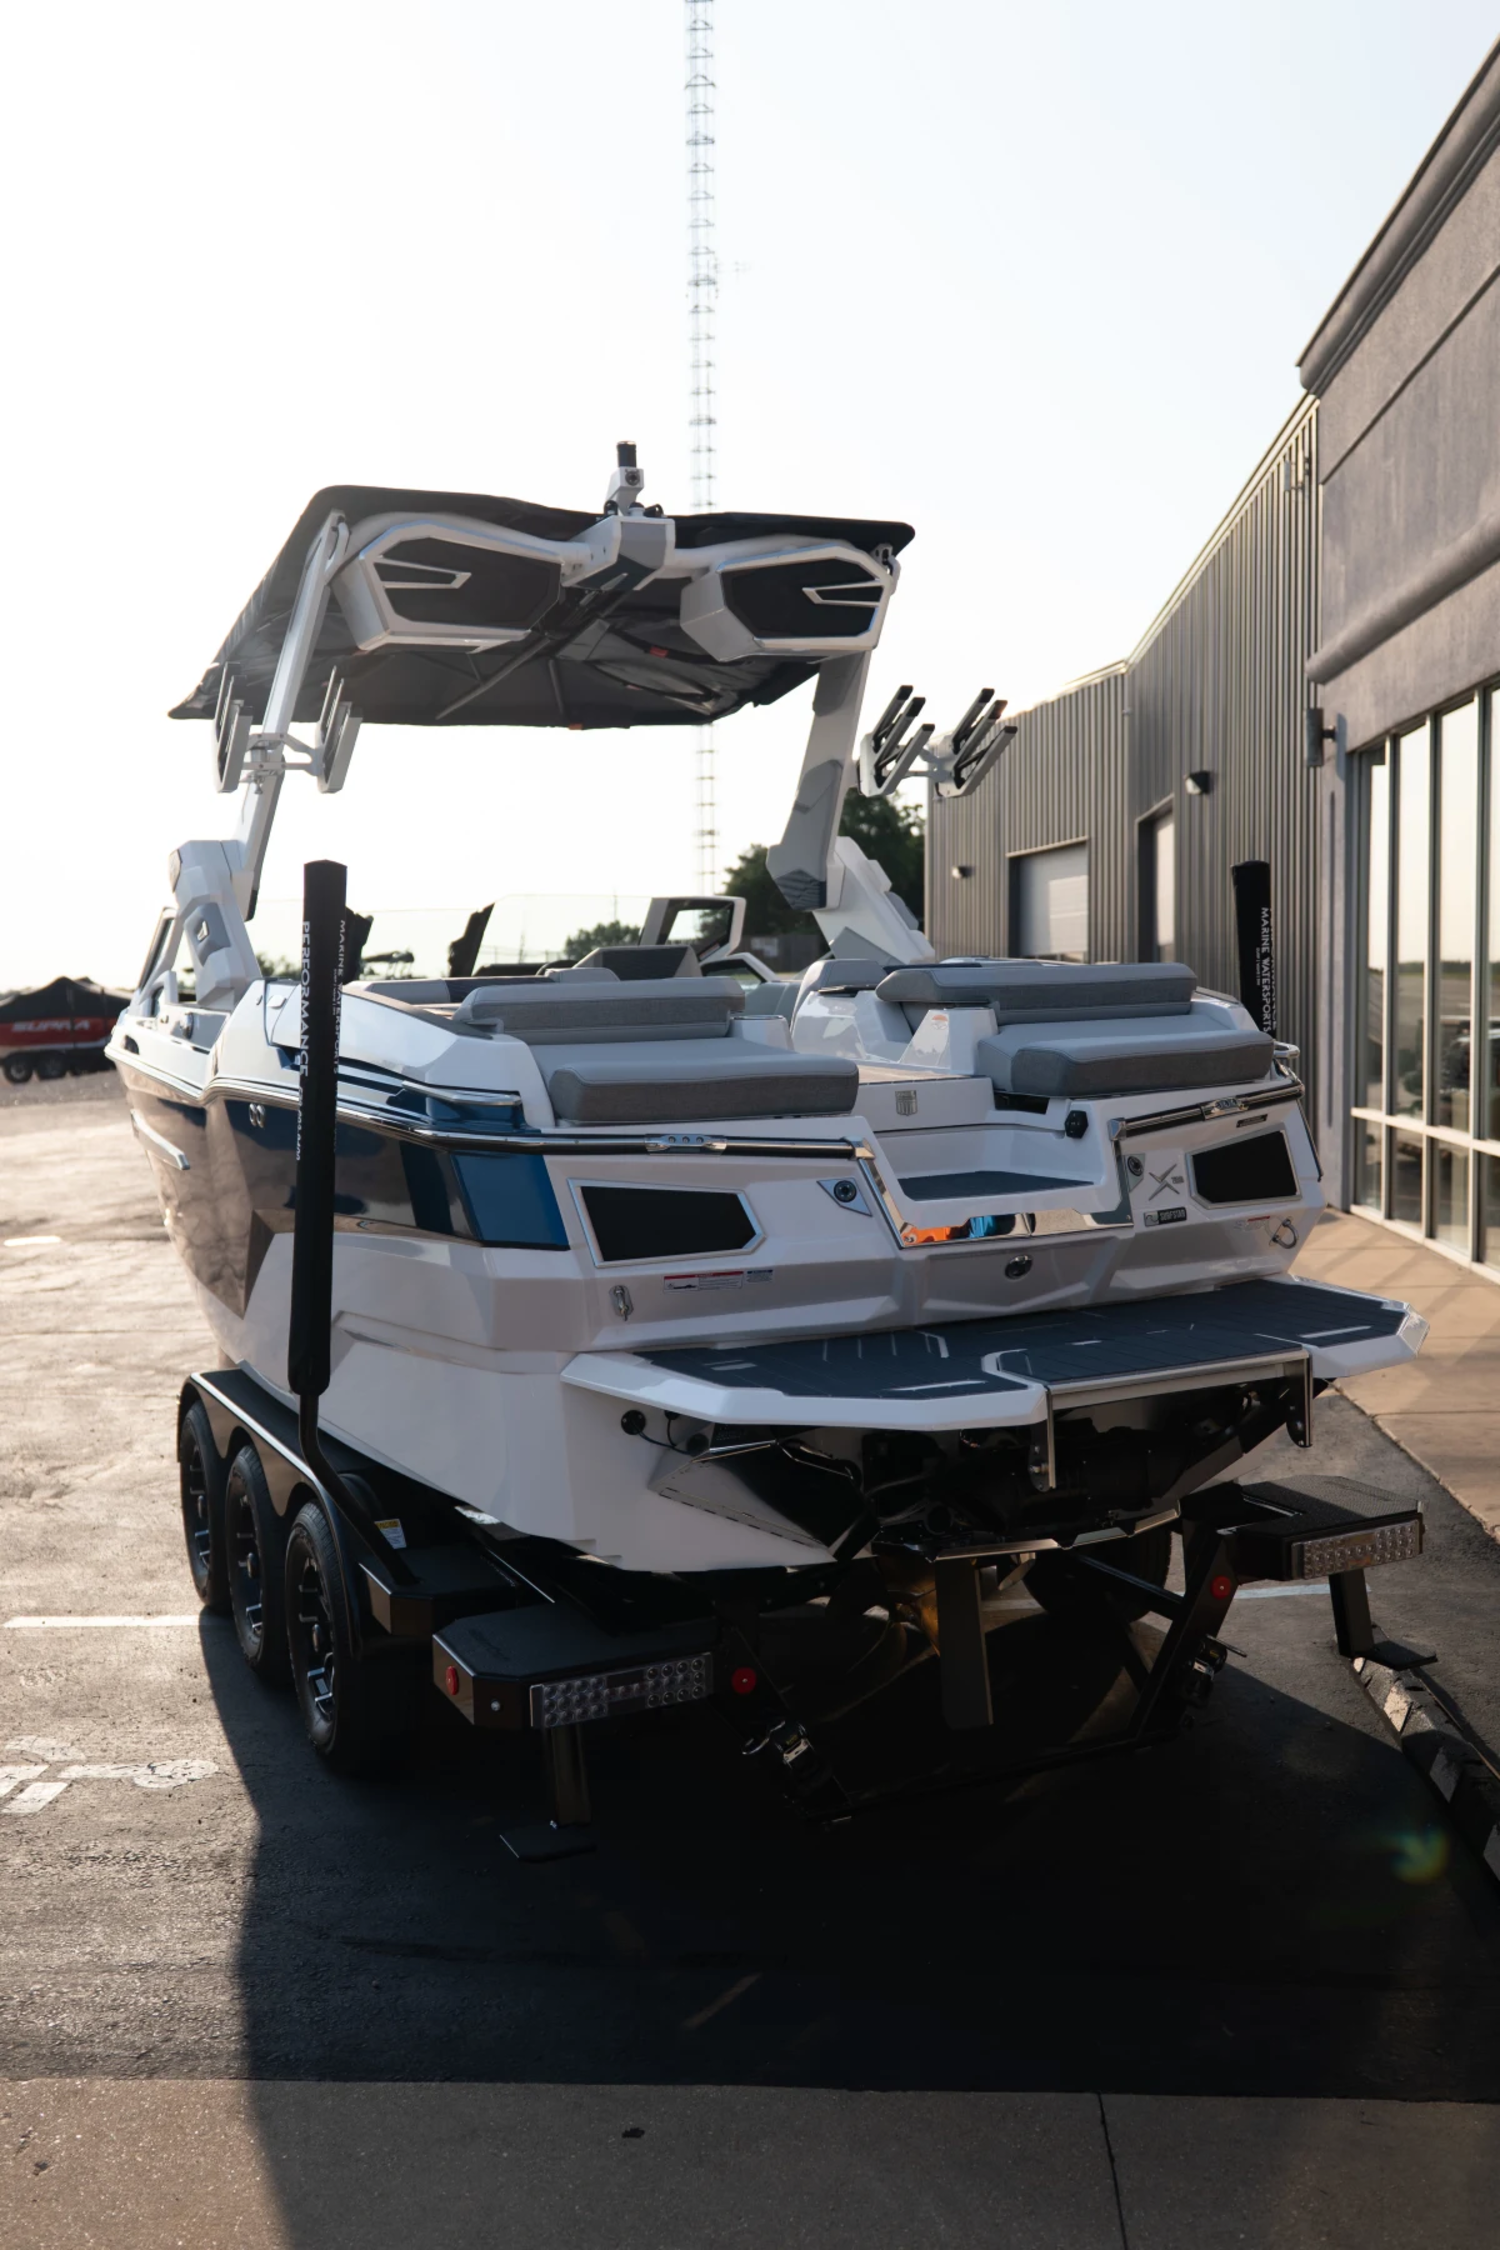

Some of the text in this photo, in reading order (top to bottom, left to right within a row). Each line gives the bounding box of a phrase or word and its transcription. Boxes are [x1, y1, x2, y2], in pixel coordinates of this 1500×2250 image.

[337, 919, 346, 977] MARINE
[1261, 907, 1272, 1032] MARINE WATERSPORTS
[11, 1019, 91, 1033] SUPRA
[300, 921, 310, 1077] PERFORMANCE
